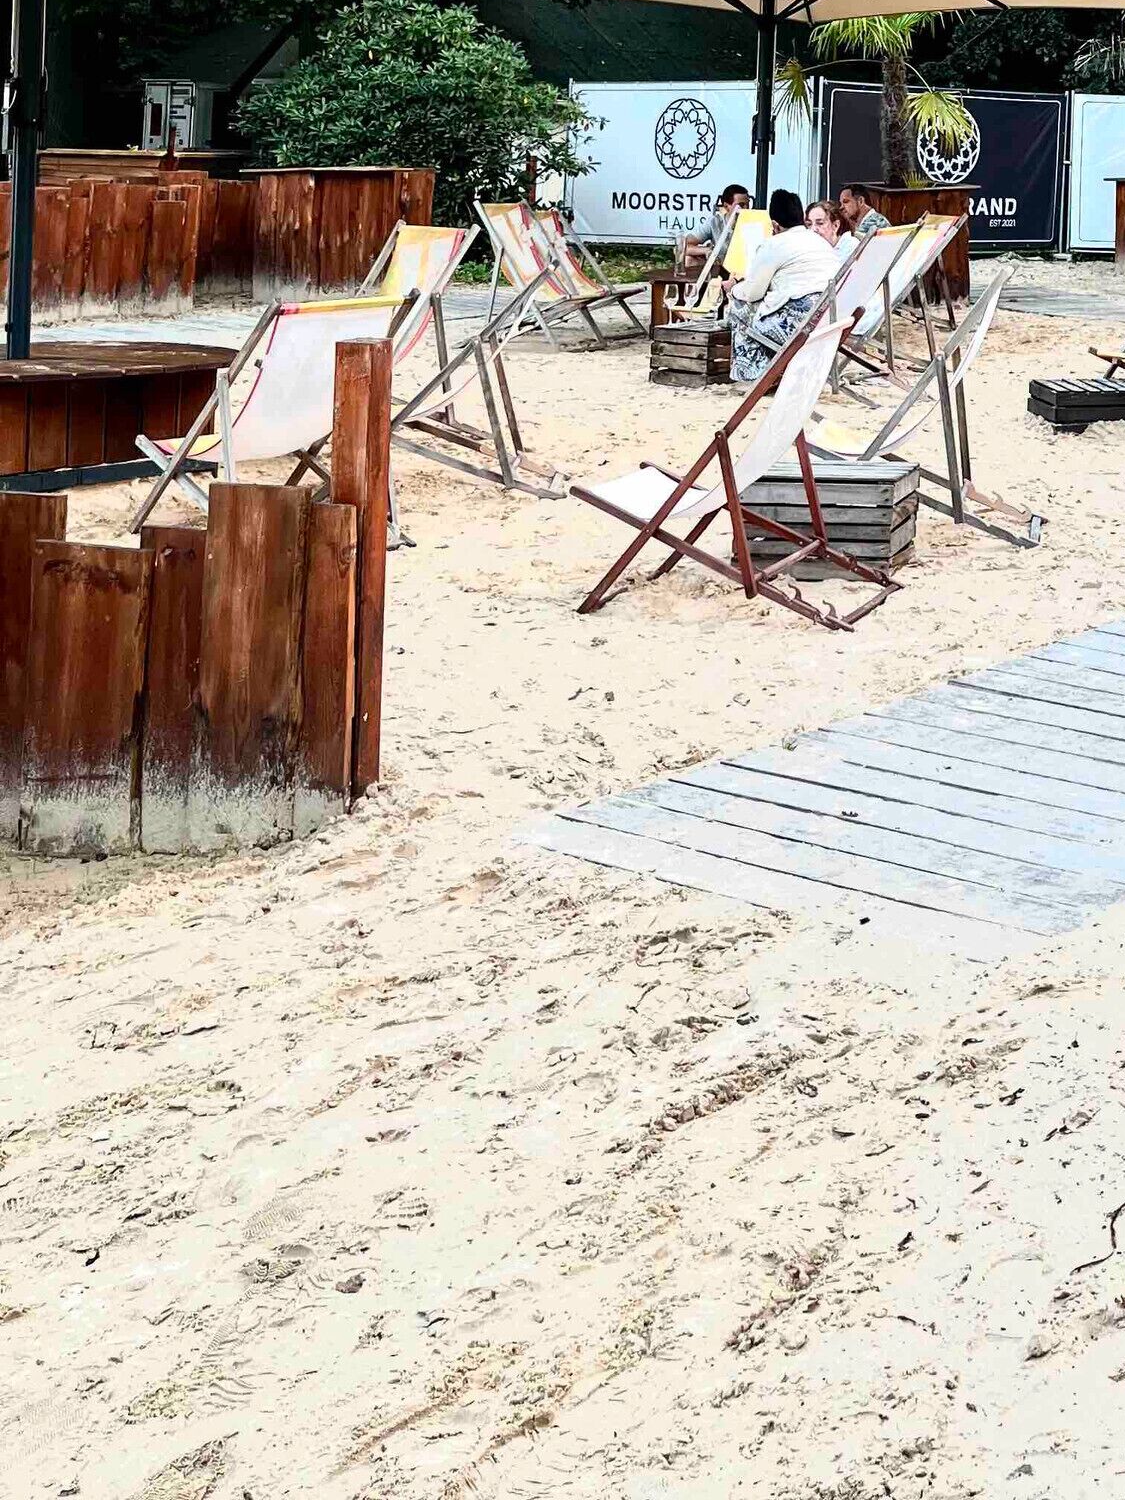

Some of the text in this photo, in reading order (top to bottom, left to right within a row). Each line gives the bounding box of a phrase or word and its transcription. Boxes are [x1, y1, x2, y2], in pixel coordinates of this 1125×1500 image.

[612, 192, 756, 211] MOORSTRA
[989, 219, 1016, 227] EST 2021
